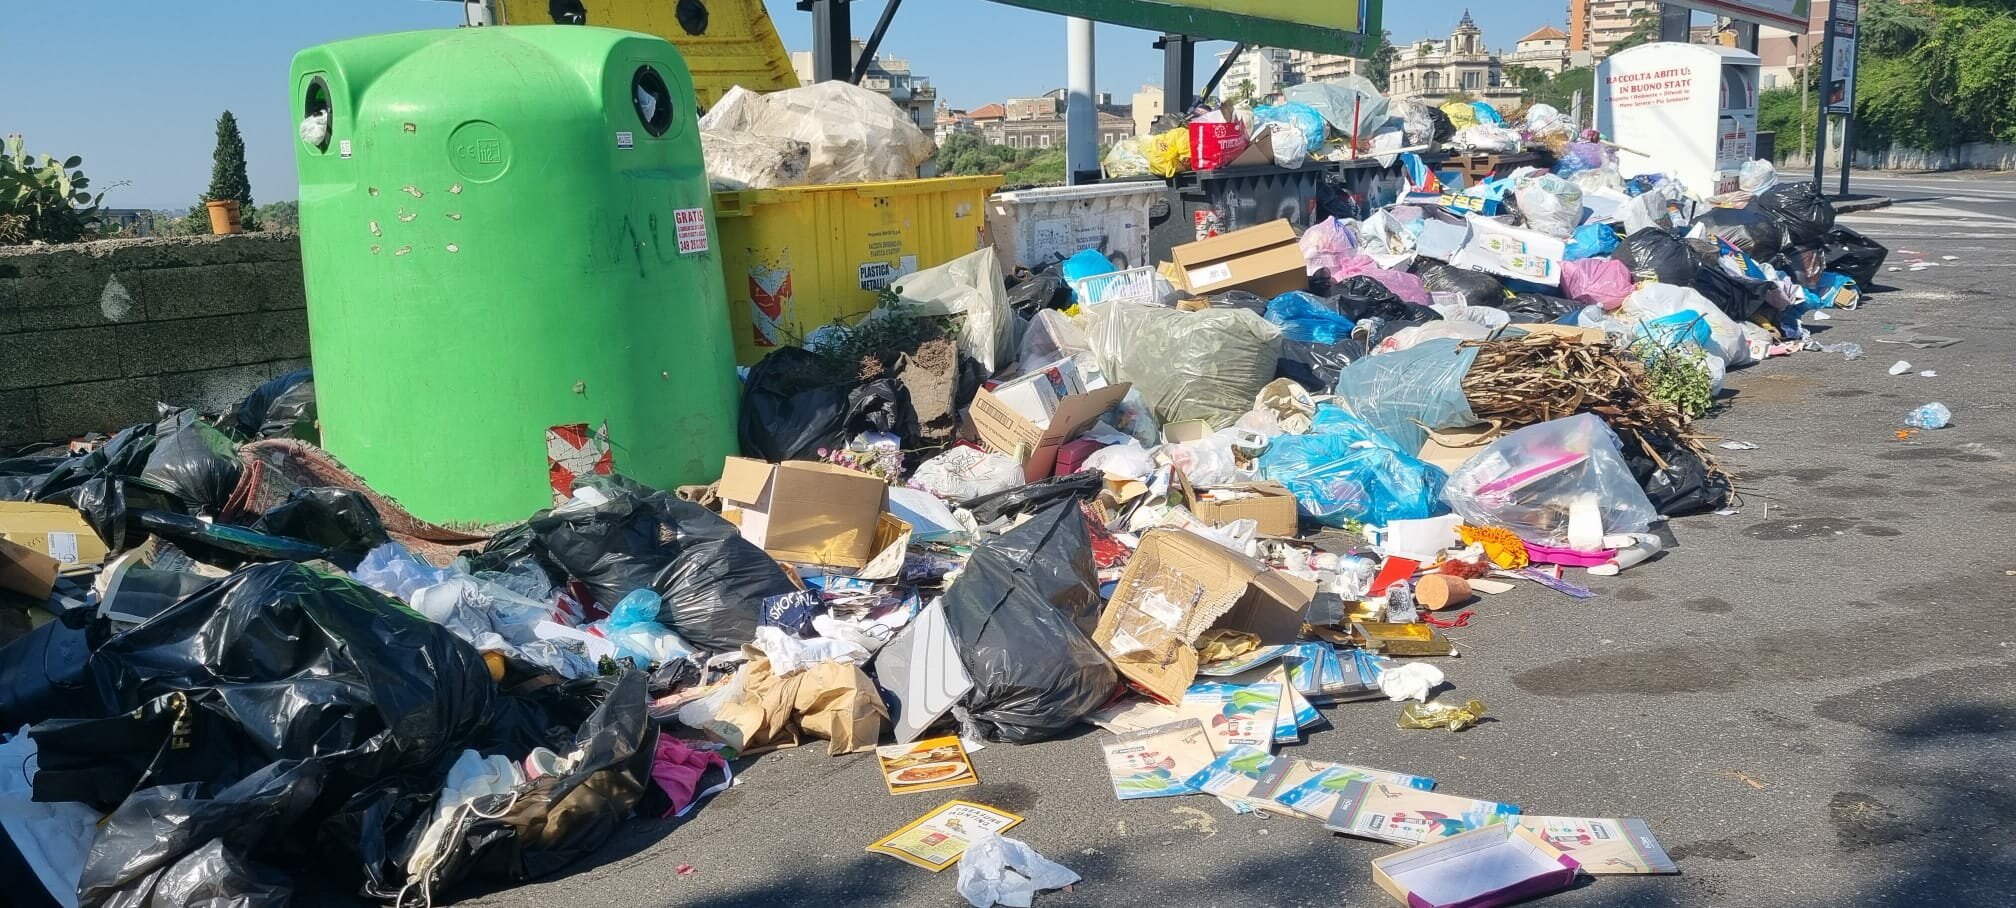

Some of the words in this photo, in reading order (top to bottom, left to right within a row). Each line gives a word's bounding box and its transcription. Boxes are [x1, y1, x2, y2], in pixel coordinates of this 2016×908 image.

[1606, 73, 1652, 85] RACCOLTA
[1654, 69, 1678, 79] ABITI
[1620, 86, 1629, 94] IN
[1631, 83, 1662, 93] BUONO
[676, 209, 704, 224] GRATIS
[860, 263, 890, 279] PLASTICA
